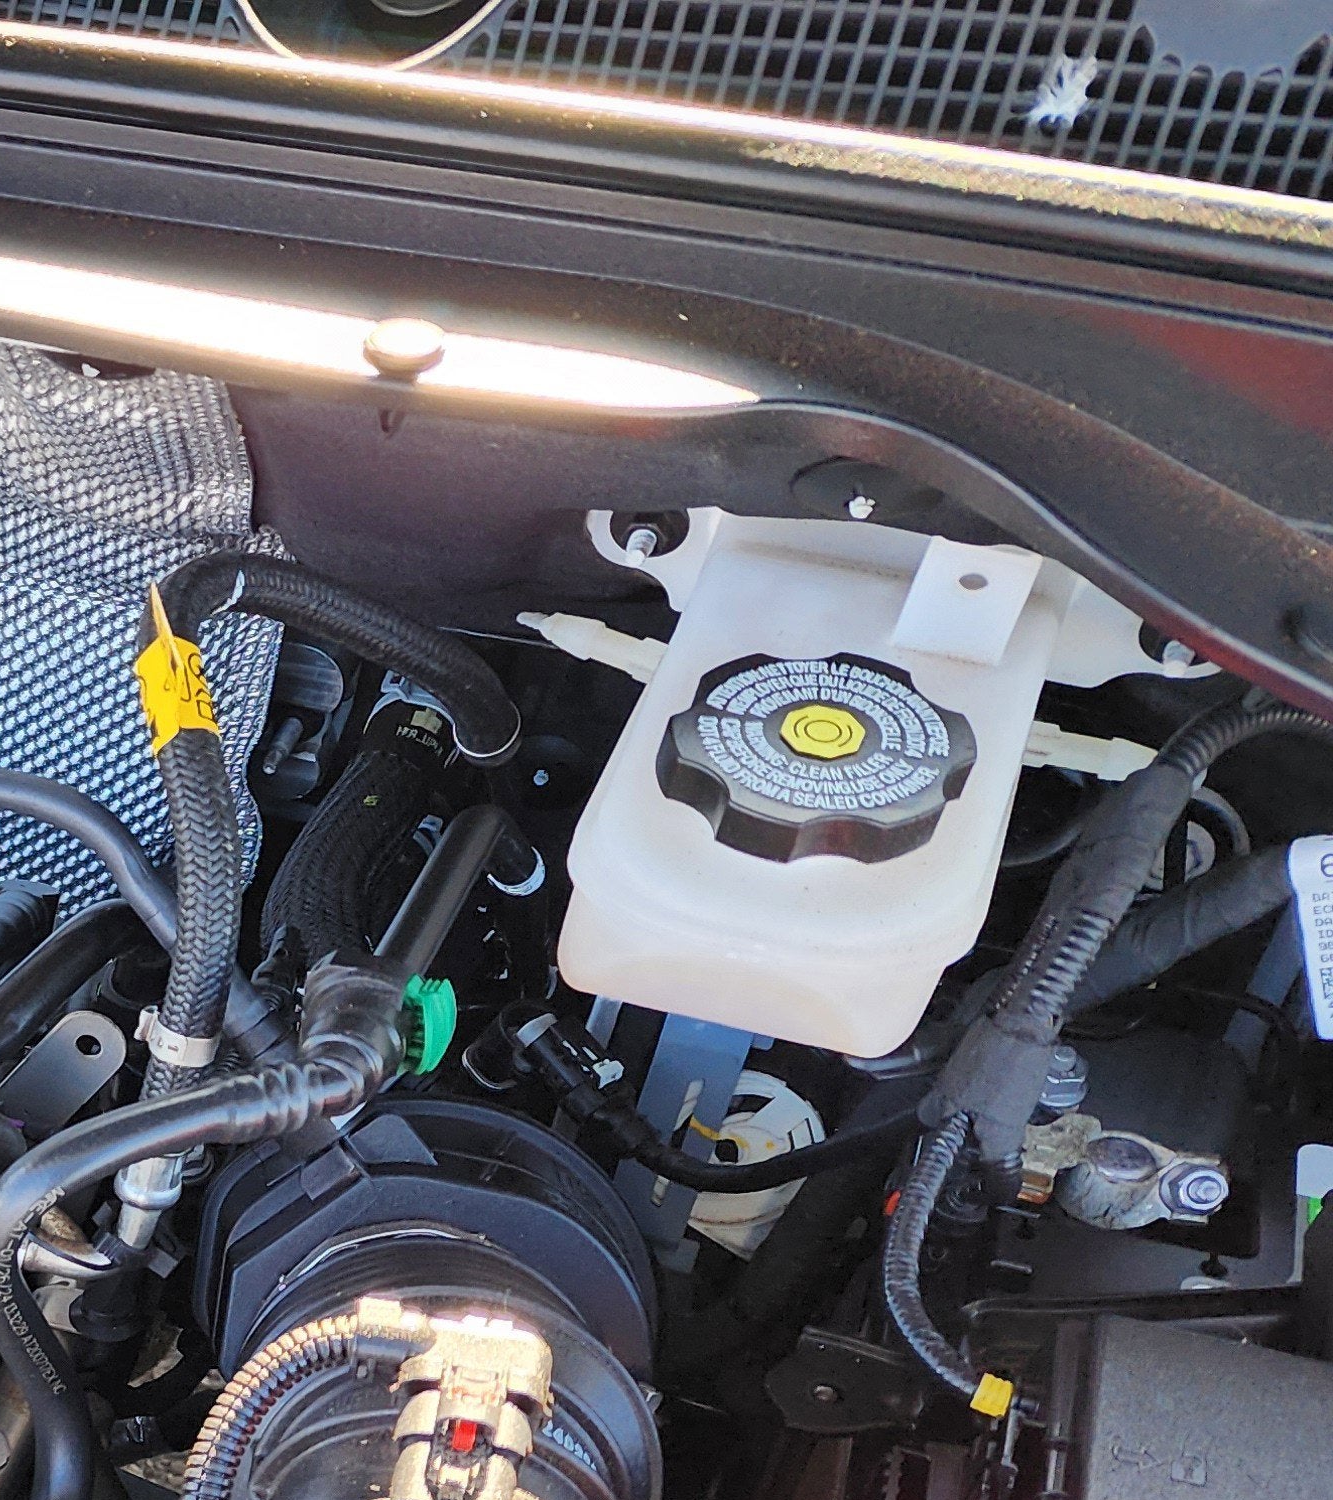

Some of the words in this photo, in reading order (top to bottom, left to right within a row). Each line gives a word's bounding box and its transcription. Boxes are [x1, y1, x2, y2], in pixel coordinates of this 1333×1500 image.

[831, 663, 850, 677] LE
[789, 673, 818, 687] QUE
[819, 674, 838, 687] DU
[881, 697, 906, 712] DE
[725, 738, 770, 780] BEFORE
[849, 777, 881, 793] USE
[880, 758, 916, 784] ONLY
[789, 762, 843, 781] CLEAN
[846, 753, 894, 780] FILLER
[733, 768, 778, 799] FROM
[774, 789, 791, 804] A
[793, 791, 859, 811] SEALED
